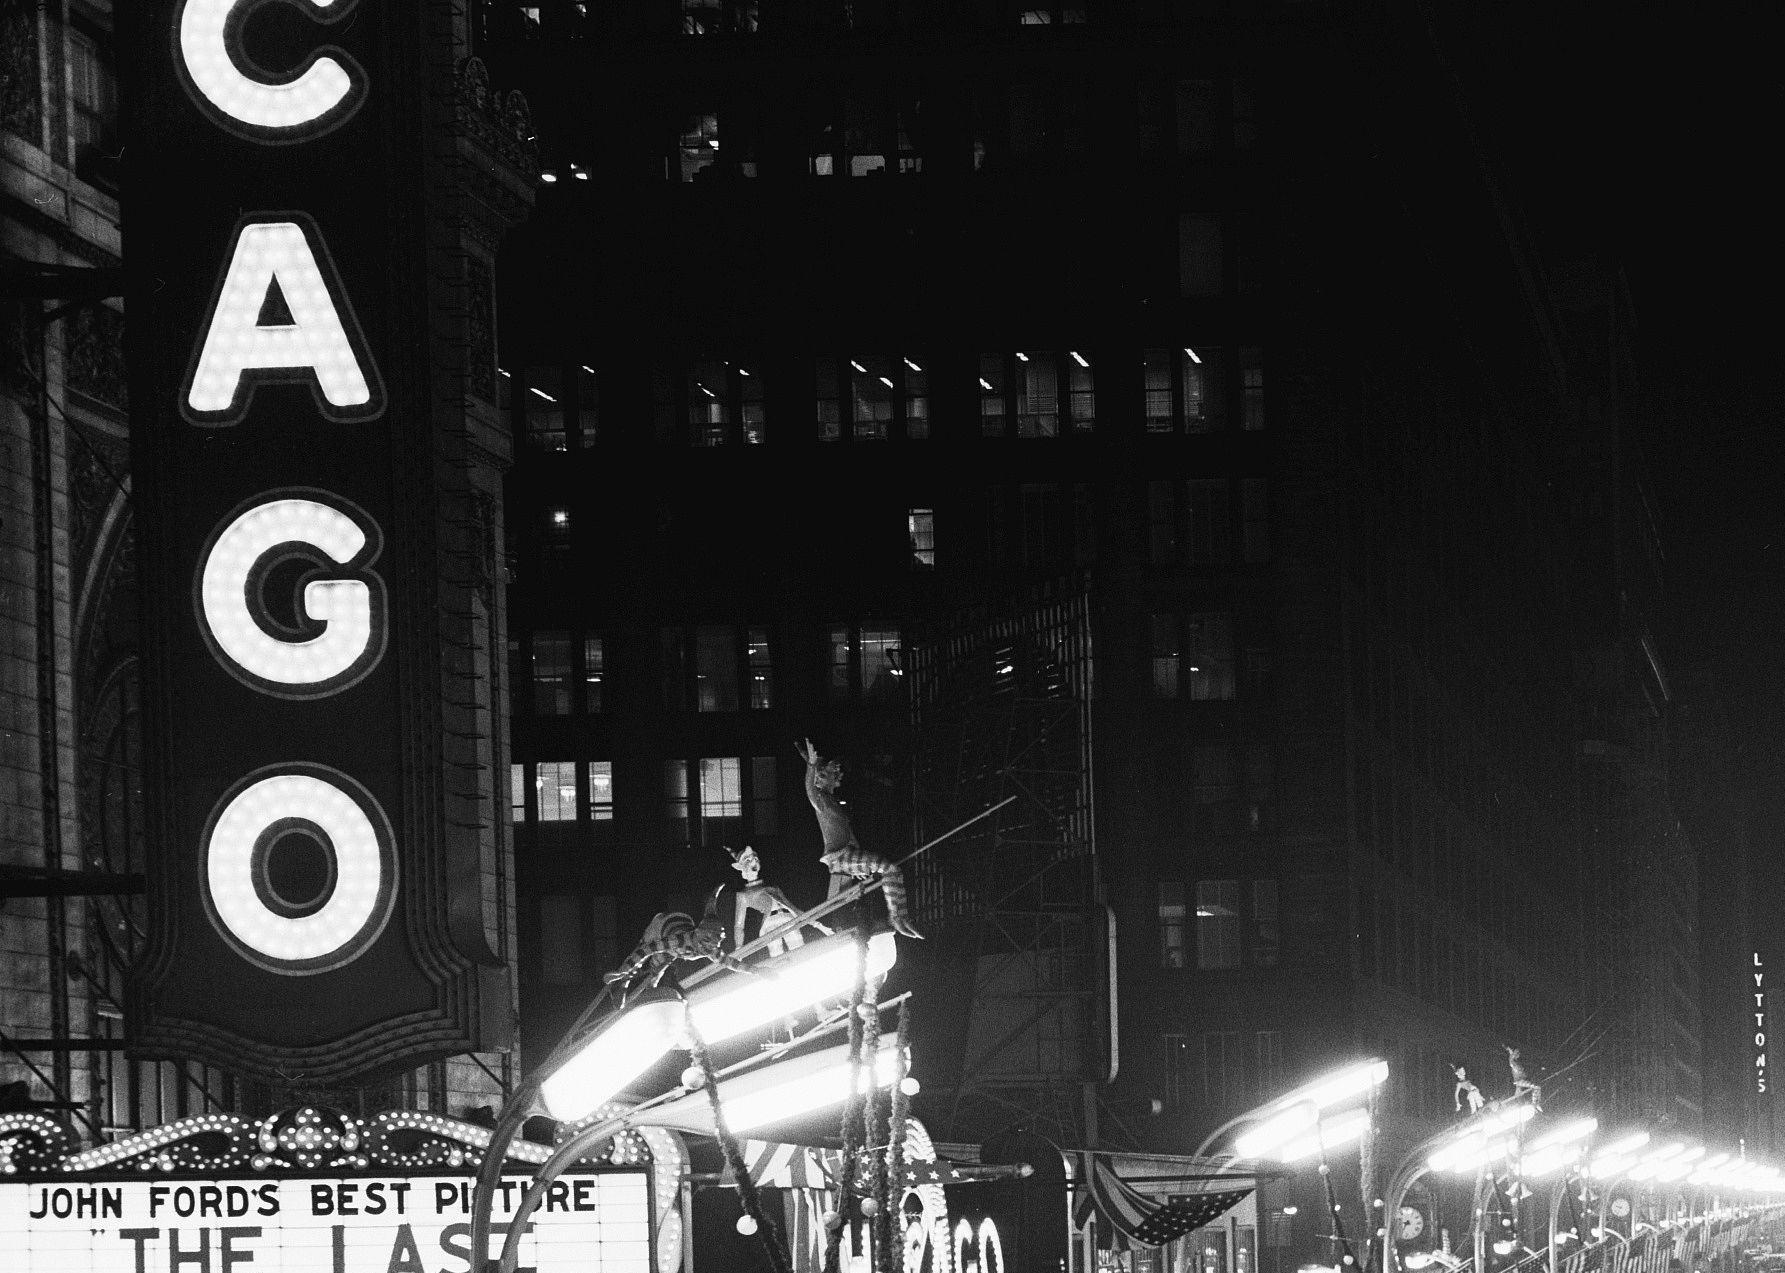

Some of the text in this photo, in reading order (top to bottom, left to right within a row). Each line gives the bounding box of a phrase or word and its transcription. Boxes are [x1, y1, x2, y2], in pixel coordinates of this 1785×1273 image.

[180, 0, 382, 960] CAGO
[1753, 952, 1766, 1093] LYTTON'S
[30, 1180, 595, 1219] JOHN FORD'S BEST PITRE
